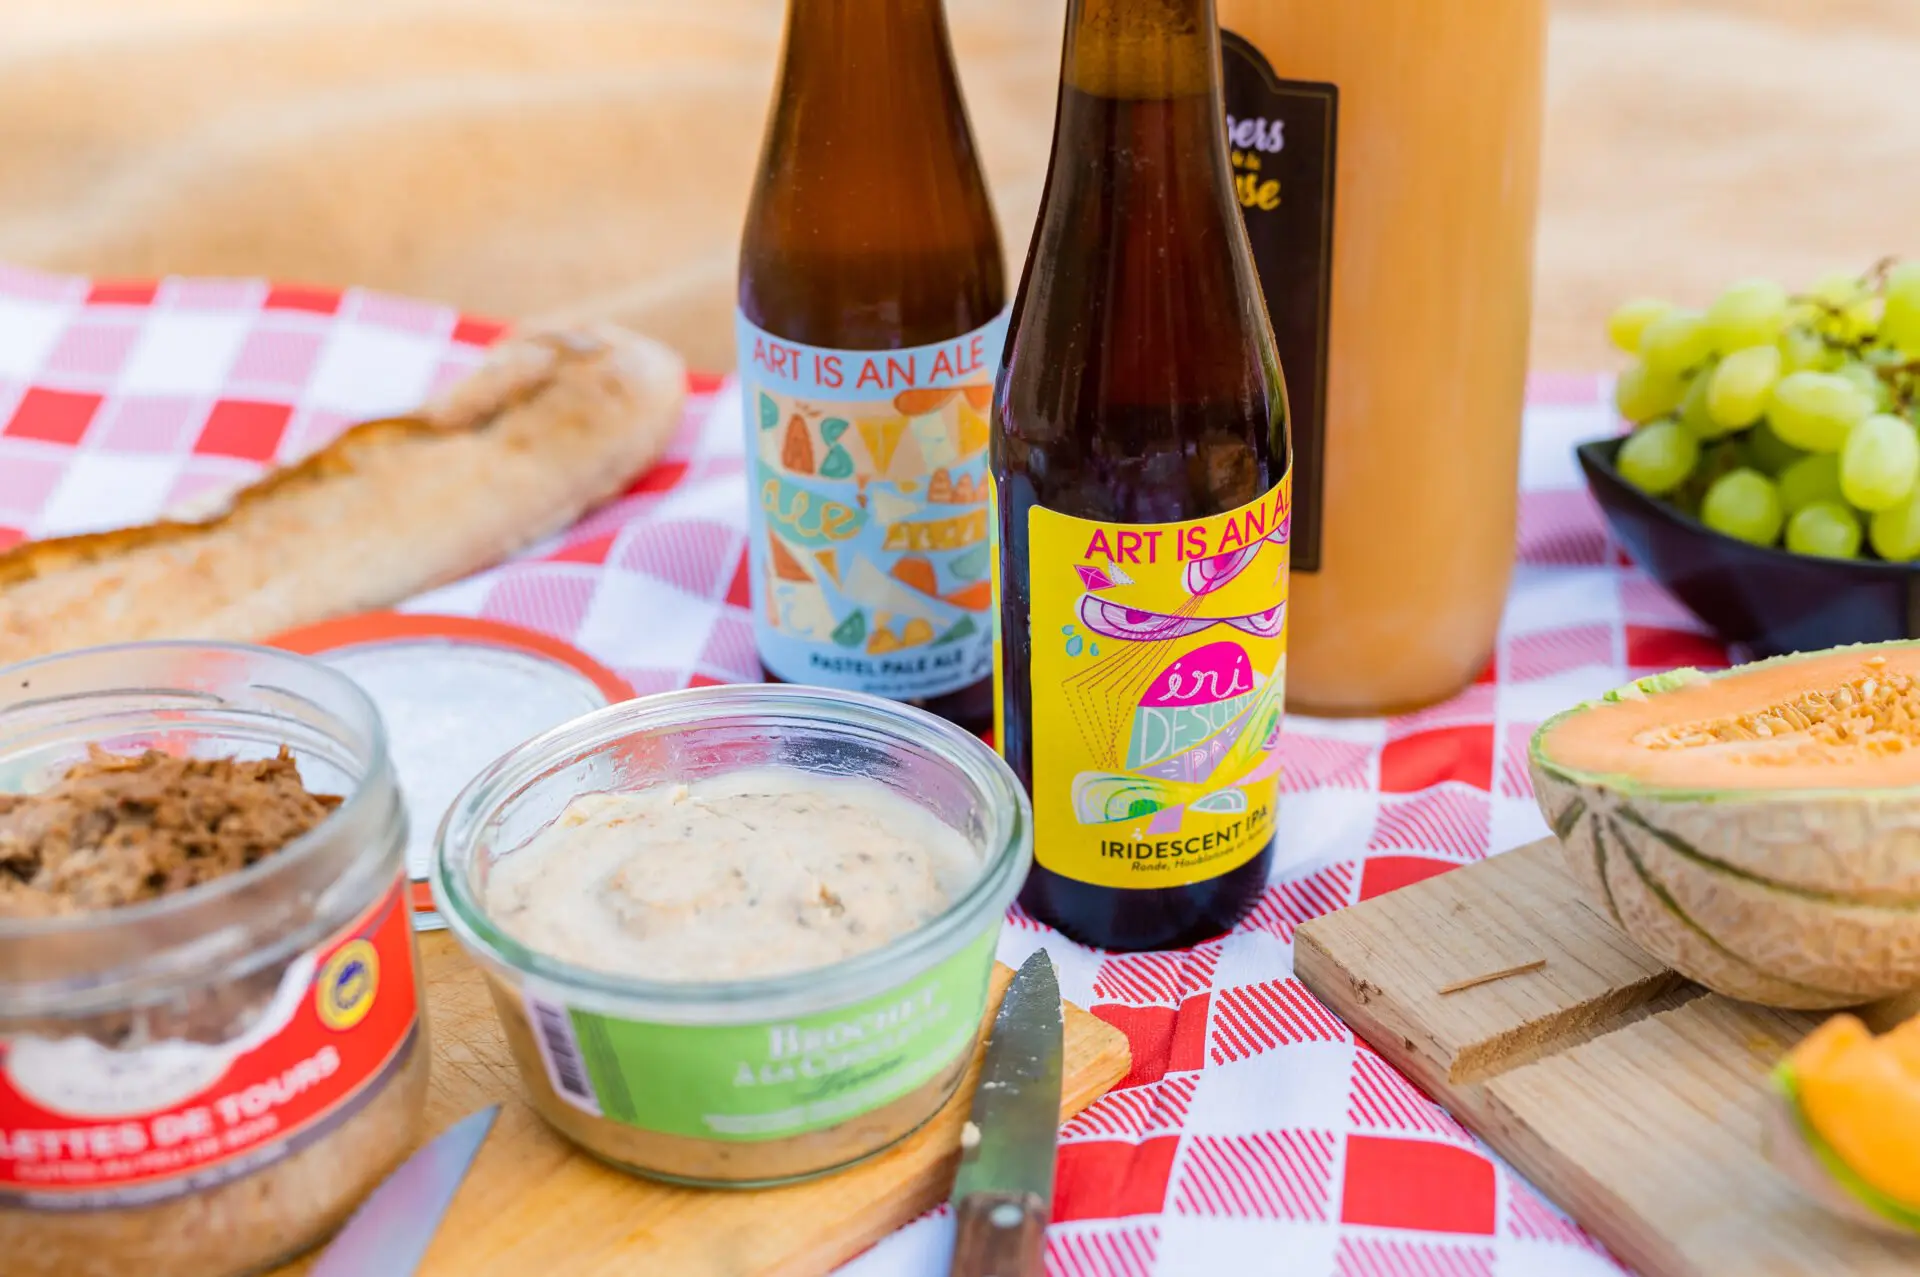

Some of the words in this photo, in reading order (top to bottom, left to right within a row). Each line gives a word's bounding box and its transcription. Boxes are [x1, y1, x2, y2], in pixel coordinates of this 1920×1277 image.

[753, 337, 801, 381] ART
[815, 355, 844, 388] IS
[856, 355, 915, 389] AN
[929, 336, 985, 383] ALE
[1084, 529, 1162, 564] ART
[1178, 526, 1207, 561] IS
[1218, 502, 1265, 553] AN
[1272, 479, 1290, 528] AL
[810, 653, 874, 675] PASTEL
[881, 657, 927, 674] PALE
[934, 649, 964, 669] ALE
[1101, 821, 1242, 860] IRIDESCENT
[1245, 804, 1268, 832] IPA
[153, 1108, 211, 1146] DE
[217, 1044, 341, 1125] TOURS
